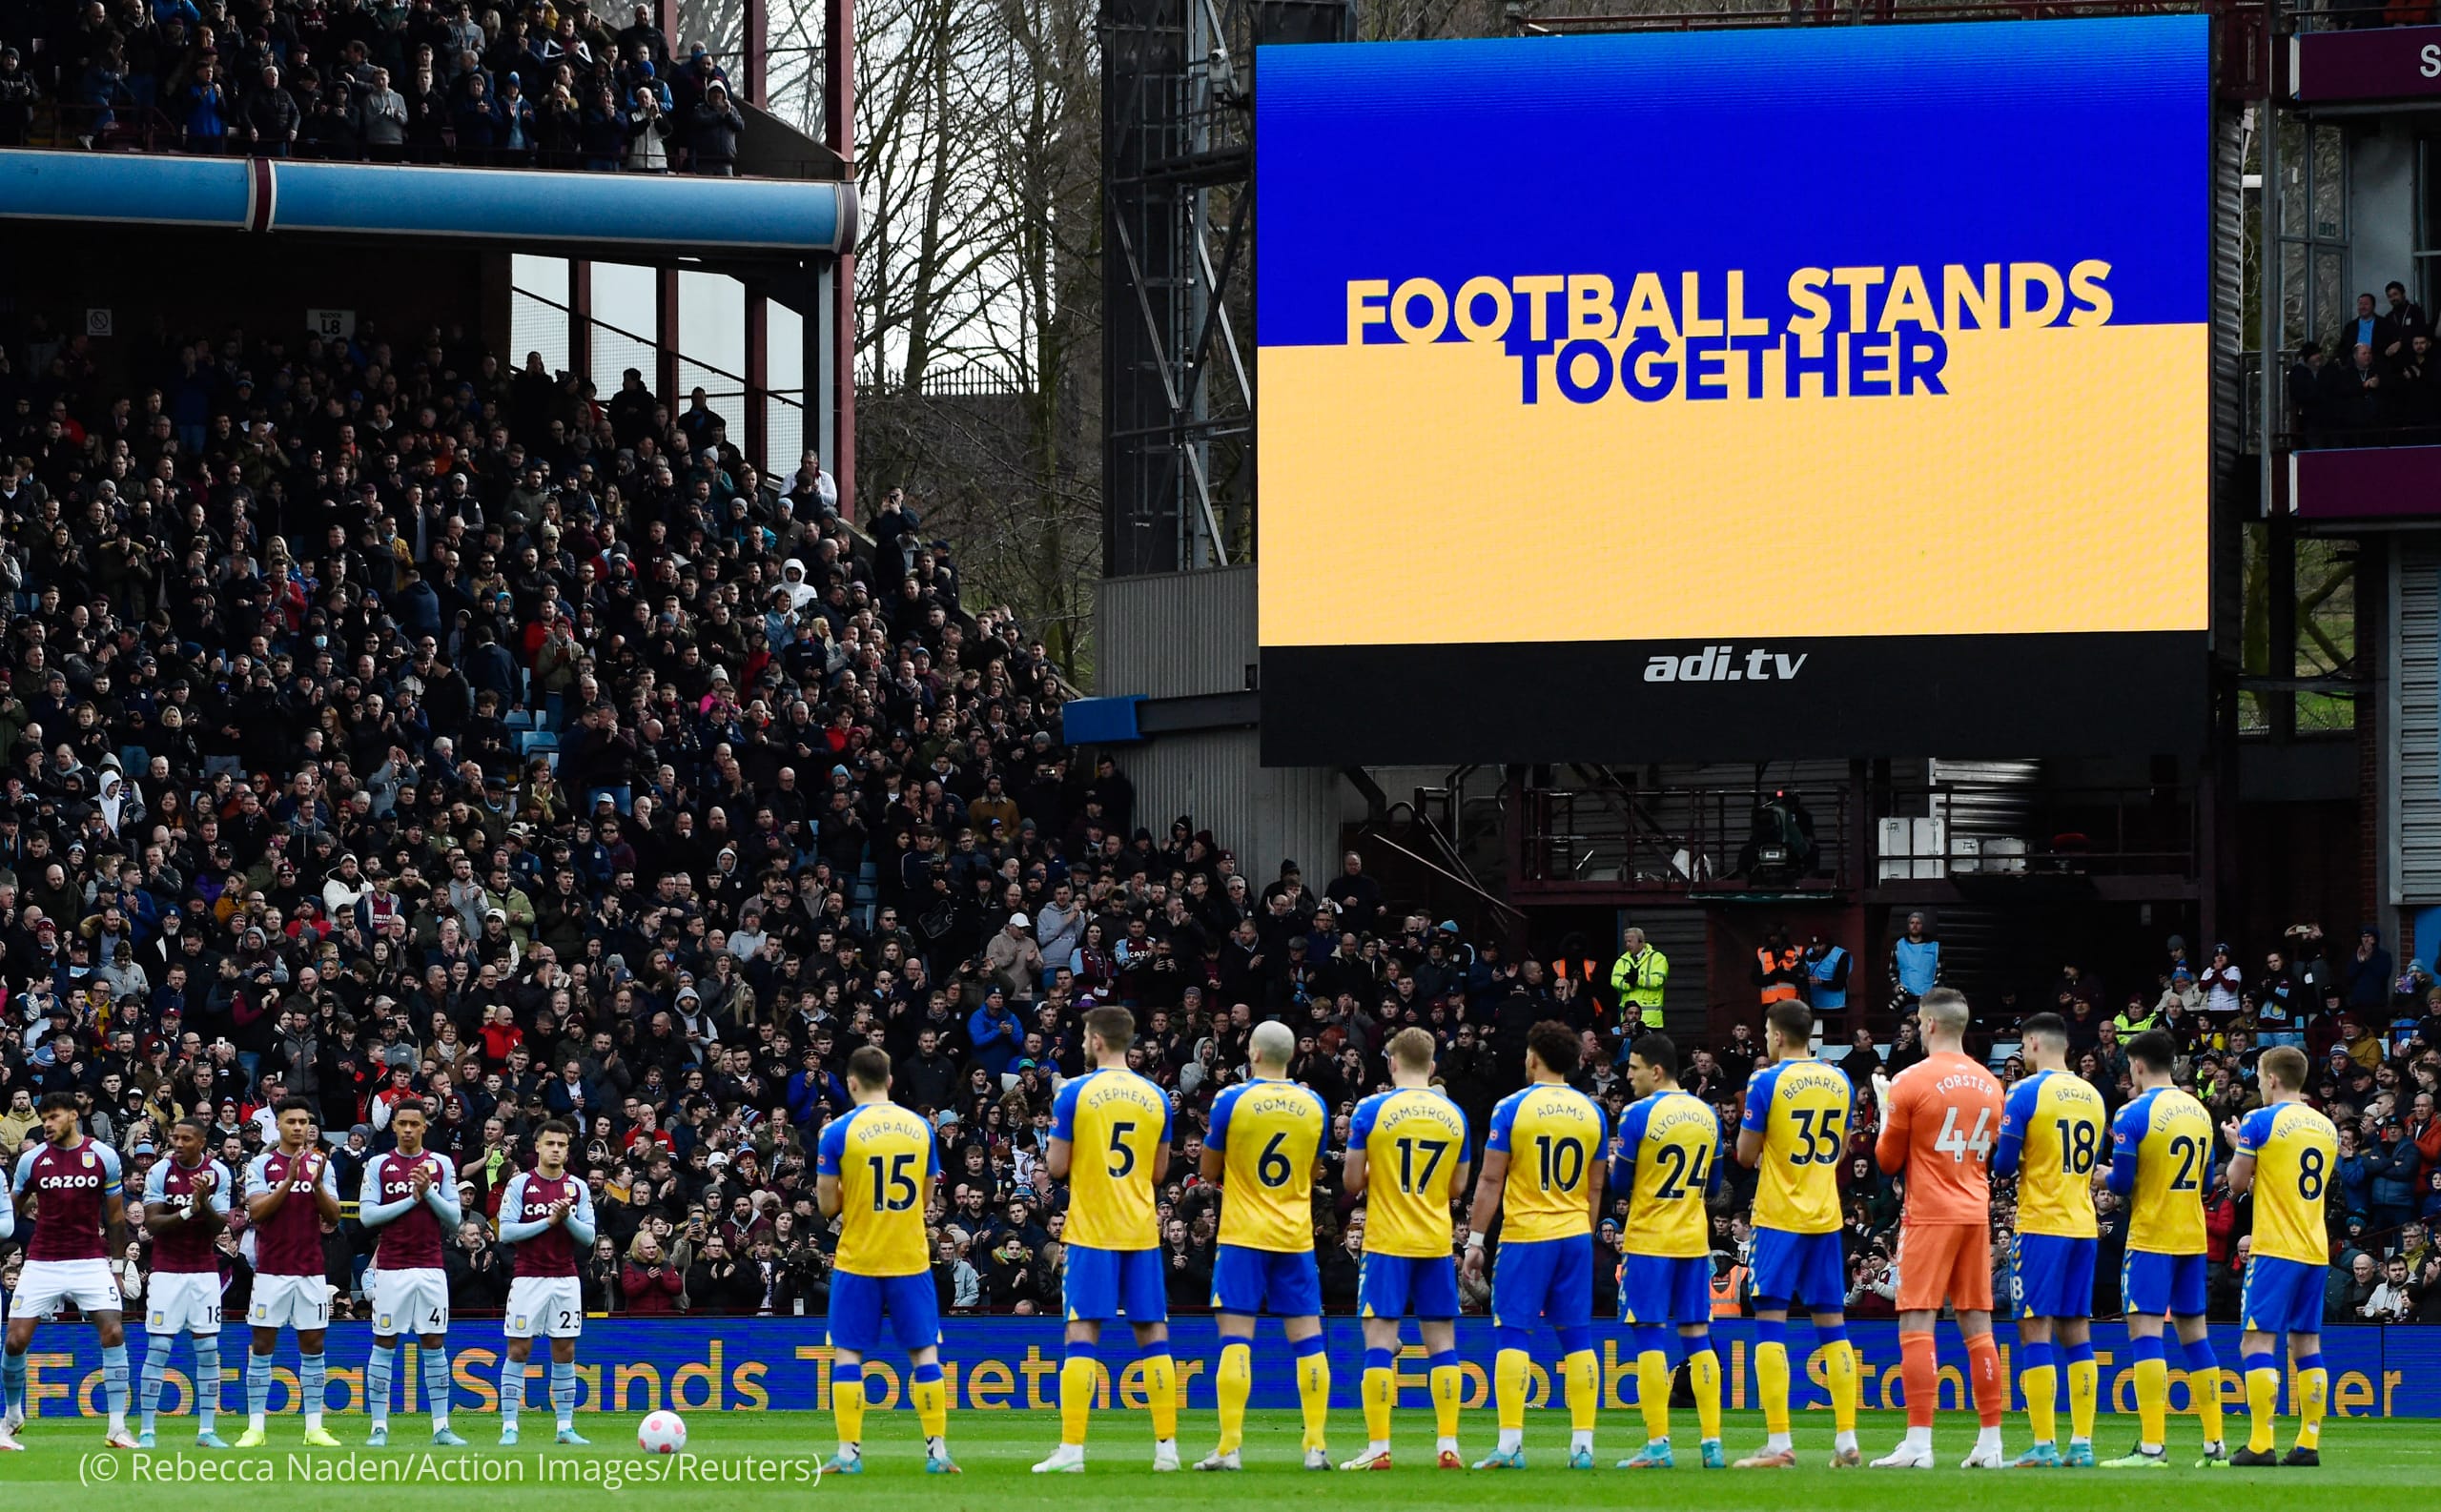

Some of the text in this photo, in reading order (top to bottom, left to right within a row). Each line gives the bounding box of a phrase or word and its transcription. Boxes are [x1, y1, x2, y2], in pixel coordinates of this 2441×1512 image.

[1346, 258, 2114, 345] FOOTBALL STANDS
[321, 319, 340, 335] L8
[1505, 330, 1949, 404] TOGETHER
[1643, 645, 1809, 683] adi.tv
[1782, 1075, 1844, 1100] BEDNAREK
[1936, 1073, 1993, 1096] FORSTER
[2055, 1088, 2092, 1105] BROJA
[1088, 1087, 1157, 1114] STEPHENS
[1253, 1097, 1307, 1117] ROMEU
[1536, 1103, 1586, 1122] ADAMS
[858, 1122, 921, 1143] PERRAUD
[1382, 1106, 1460, 1136] ARMSTRONG
[1934, 1106, 1992, 1163] 44
[2275, 1117, 2336, 1145] WARD-PROWS
[1107, 1121, 1136, 1178] 5
[1789, 1109, 1841, 1165] 35
[2056, 1118, 2096, 1175] 18
[1258, 1132, 1291, 1188] 6
[1395, 1137, 1449, 1195] 17
[1535, 1134, 1584, 1193] 10
[1654, 1143, 1708, 1198] 24
[2169, 1134, 2207, 1191] 21
[2298, 1147, 2324, 1201] 8
[39, 1175, 99, 1190] CAZOO
[867, 1153, 917, 1212] 15
[109, 1287, 119, 1302] 5
[207, 1305, 221, 1324] 18
[317, 1302, 327, 1321] 11
[429, 1307, 447, 1326] 41
[559, 1311, 581, 1329] 23
